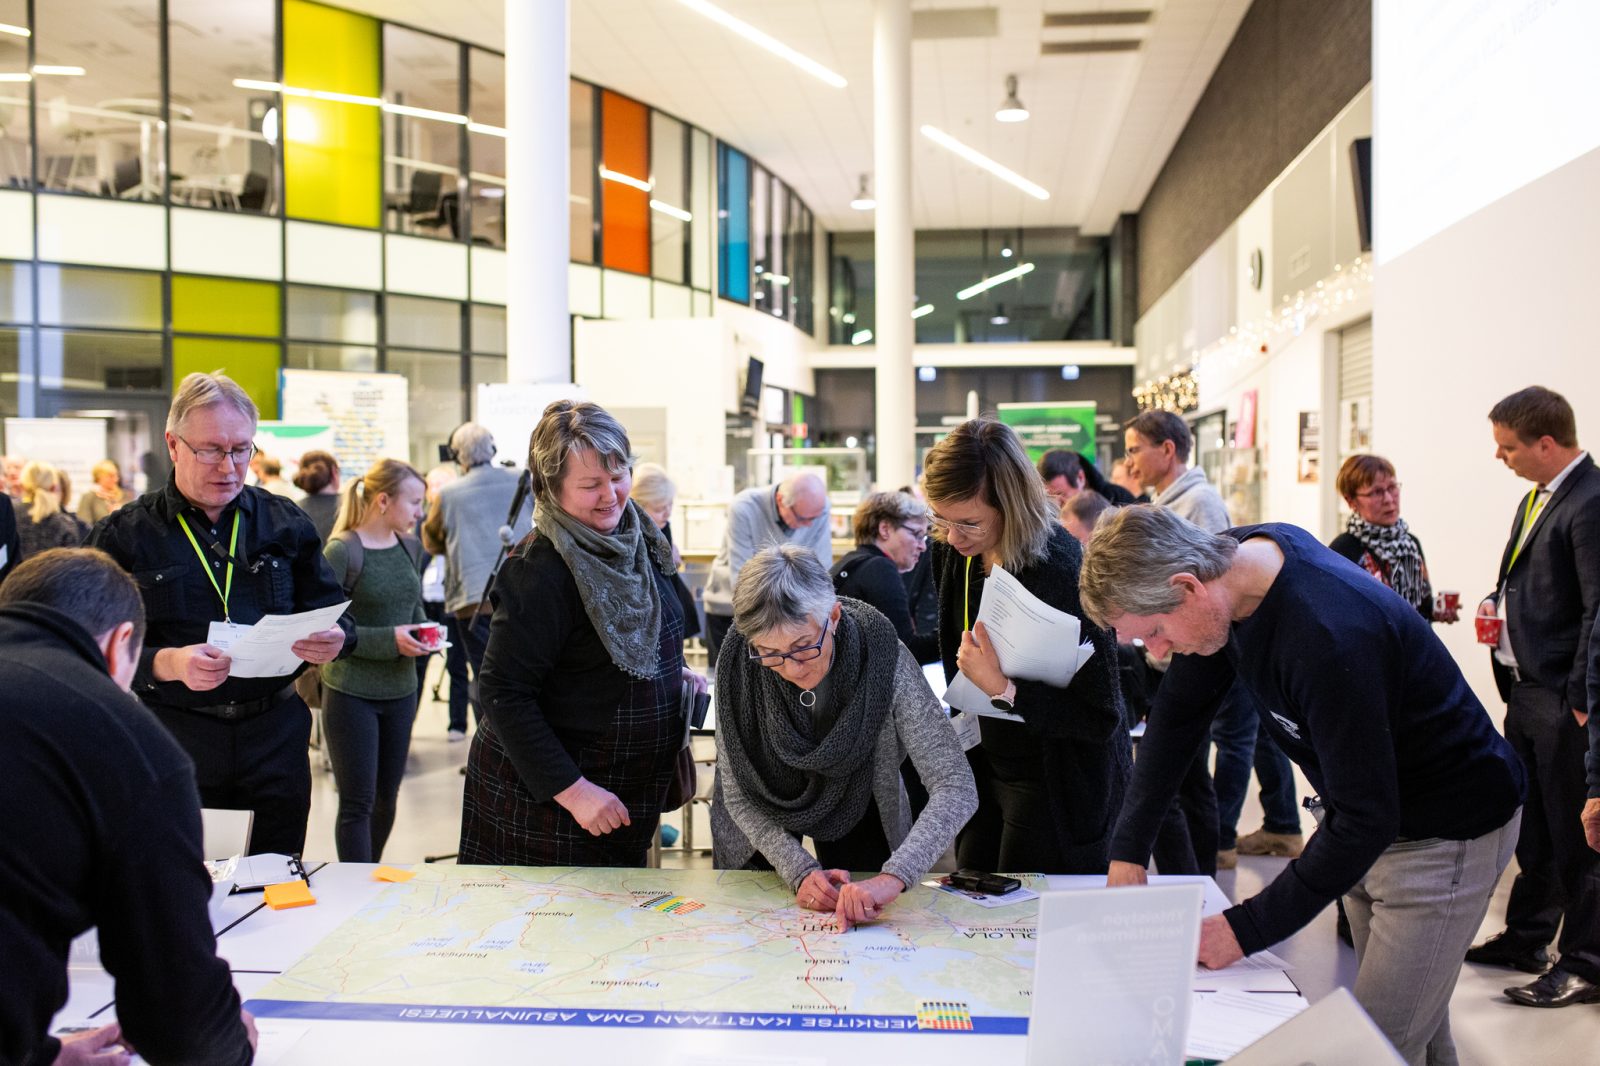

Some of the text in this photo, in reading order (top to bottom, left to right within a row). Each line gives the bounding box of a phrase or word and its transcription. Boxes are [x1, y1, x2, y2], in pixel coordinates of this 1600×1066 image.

[399, 1007, 918, 1030] MERKITSE KARTTAAN OMA ASUINALUEESI
